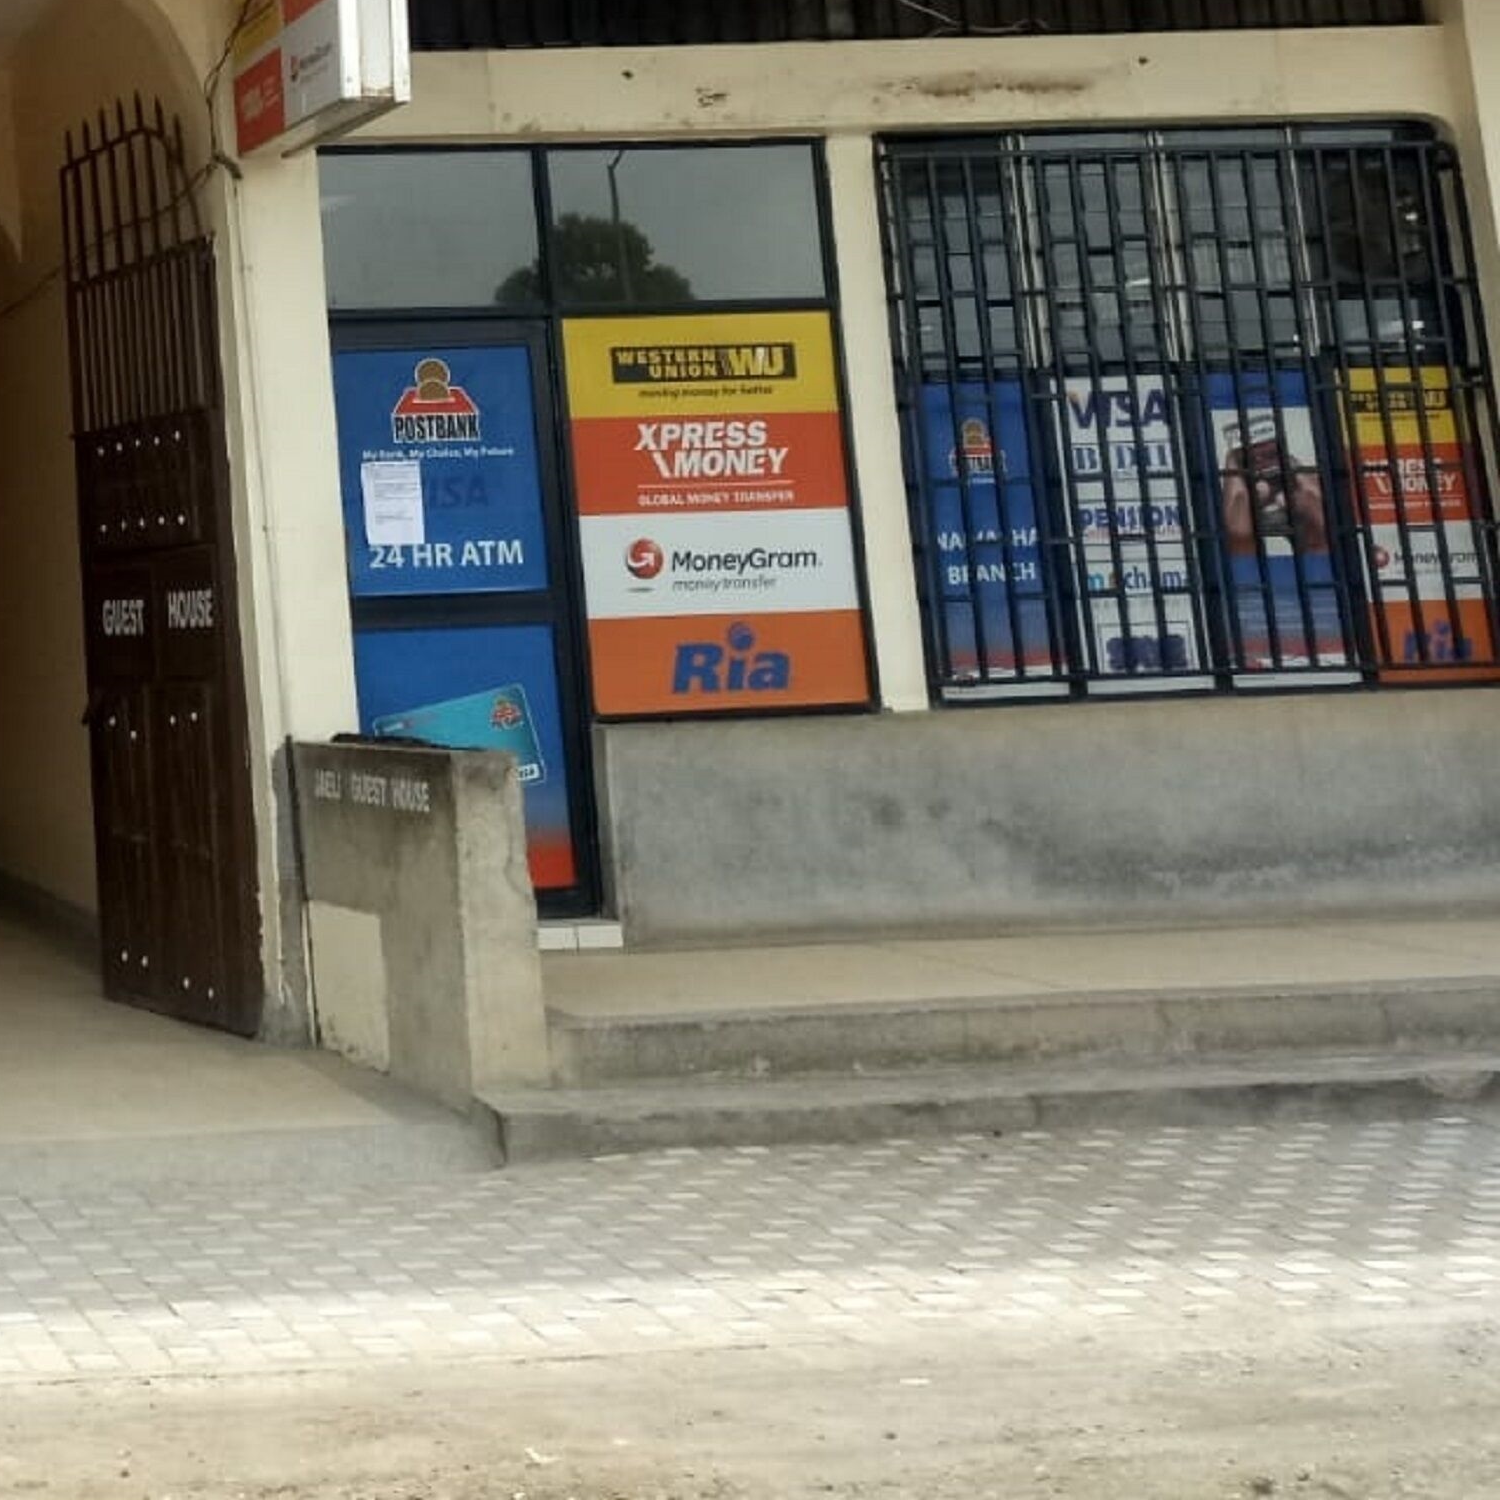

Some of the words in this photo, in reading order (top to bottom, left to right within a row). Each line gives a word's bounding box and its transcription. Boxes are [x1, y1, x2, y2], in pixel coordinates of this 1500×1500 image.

[616, 348, 716, 365] WESTERN
[650, 363, 717, 378] UNION
[394, 414, 479, 441] POSTBANK
[634, 420, 767, 451] XPRESS
[671, 448, 789, 479] MONEY
[638, 493, 684, 507] GLOBAL
[687, 491, 730, 506] MONEY
[734, 489, 794, 504] TRANSFER
[369, 545, 405, 568] 24
[413, 542, 453, 567] HR
[461, 540, 524, 566] ATM
[672, 548, 817, 575] MoneyGram
[102, 599, 145, 636] GUEST
[168, 588, 214, 628] HOUSE
[672, 621, 790, 695] Ria
